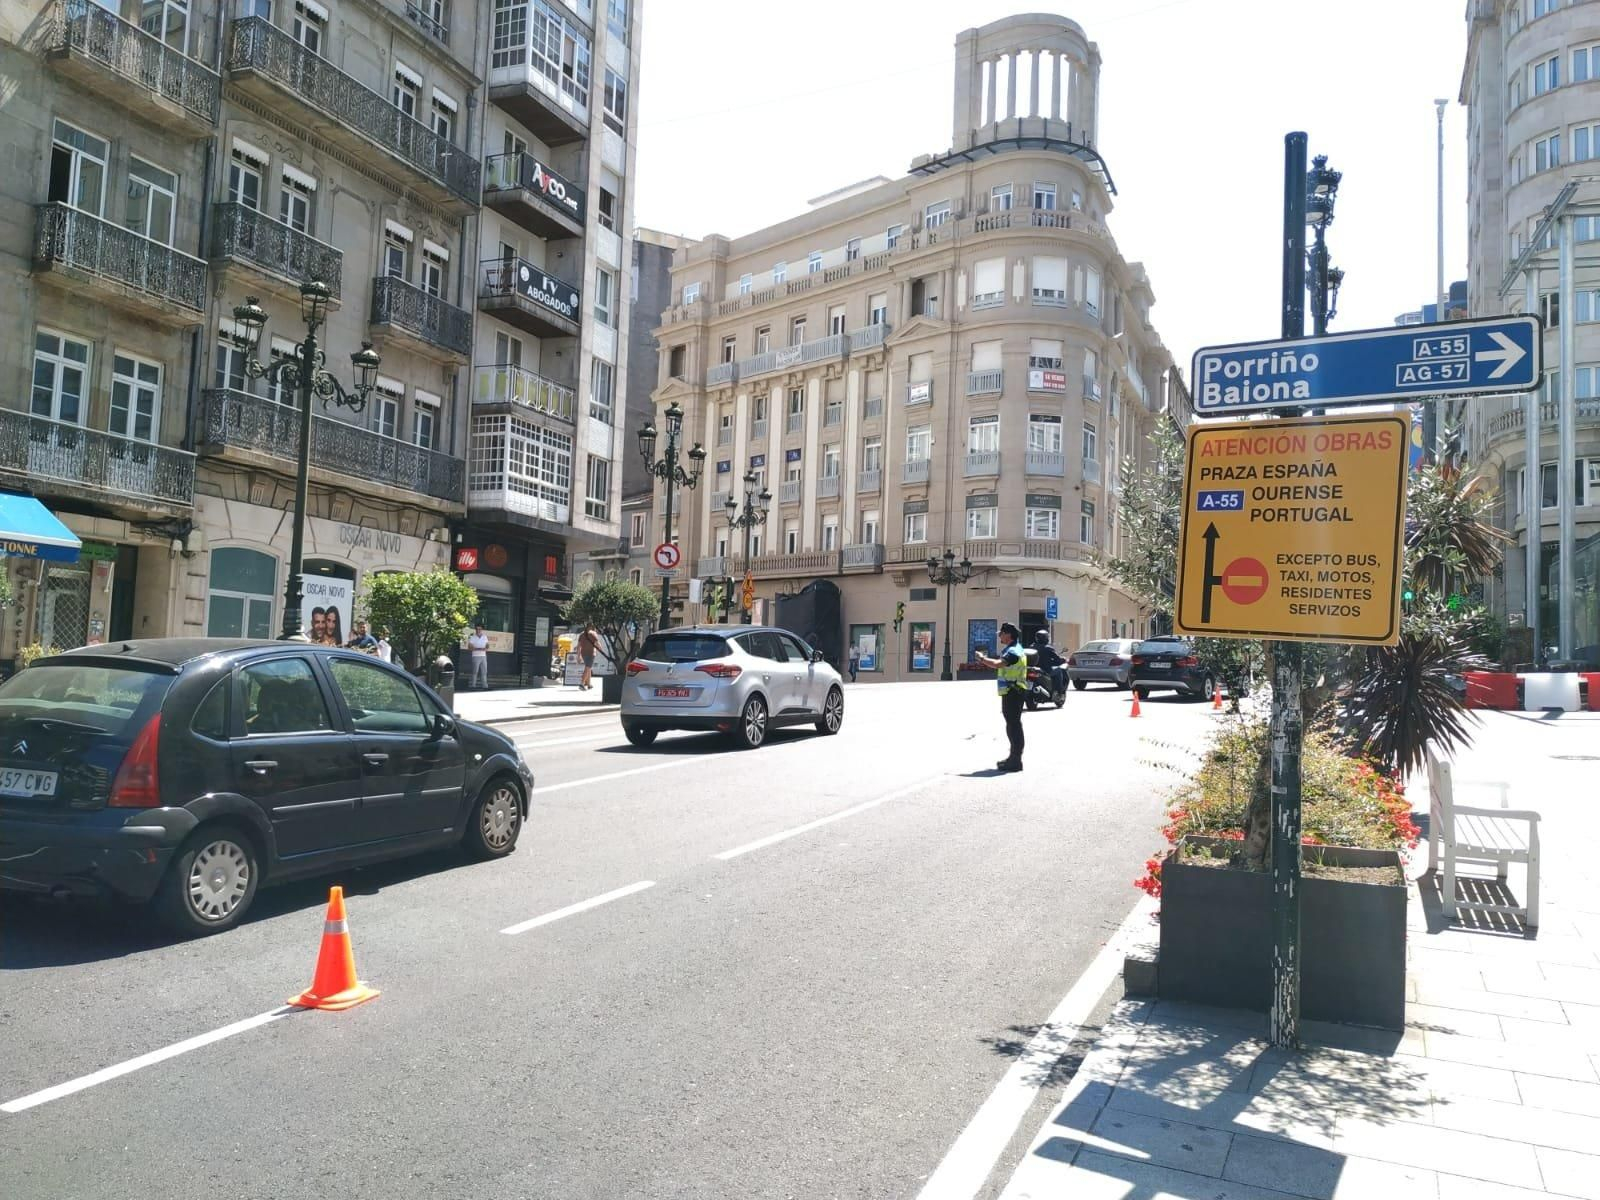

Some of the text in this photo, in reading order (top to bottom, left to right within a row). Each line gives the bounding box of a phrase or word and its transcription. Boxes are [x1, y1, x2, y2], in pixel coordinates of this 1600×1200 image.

[528, 285, 571, 316] ABOGADOS
[1418, 339, 1465, 357] A-55
[1204, 351, 1319, 382] Porriño
[1402, 363, 1465, 382] AG-57
[1203, 380, 1310, 405] Baiona
[1201, 430, 1392, 457] ATENCIÓN OBRAS
[1201, 459, 1337, 481] PRAZA ESPAÑA
[1203, 494, 1238, 508] A-55
[1252, 485, 1343, 501] OURENSE
[1250, 507, 1353, 522] PORTUGAL
[340, 526, 401, 554] OSCAR NOVO
[458, 551, 476, 567] illy
[1276, 553, 1381, 568] EXCEPTO BUS,
[1280, 570, 1375, 585] TAXI, MOTOS,
[306, 583, 345, 598] OSCAR NOVO
[1281, 587, 1372, 600] RESIDENTES
[1289, 603, 1361, 617] SERVIZOS
[25, 774, 52, 791] CWG
